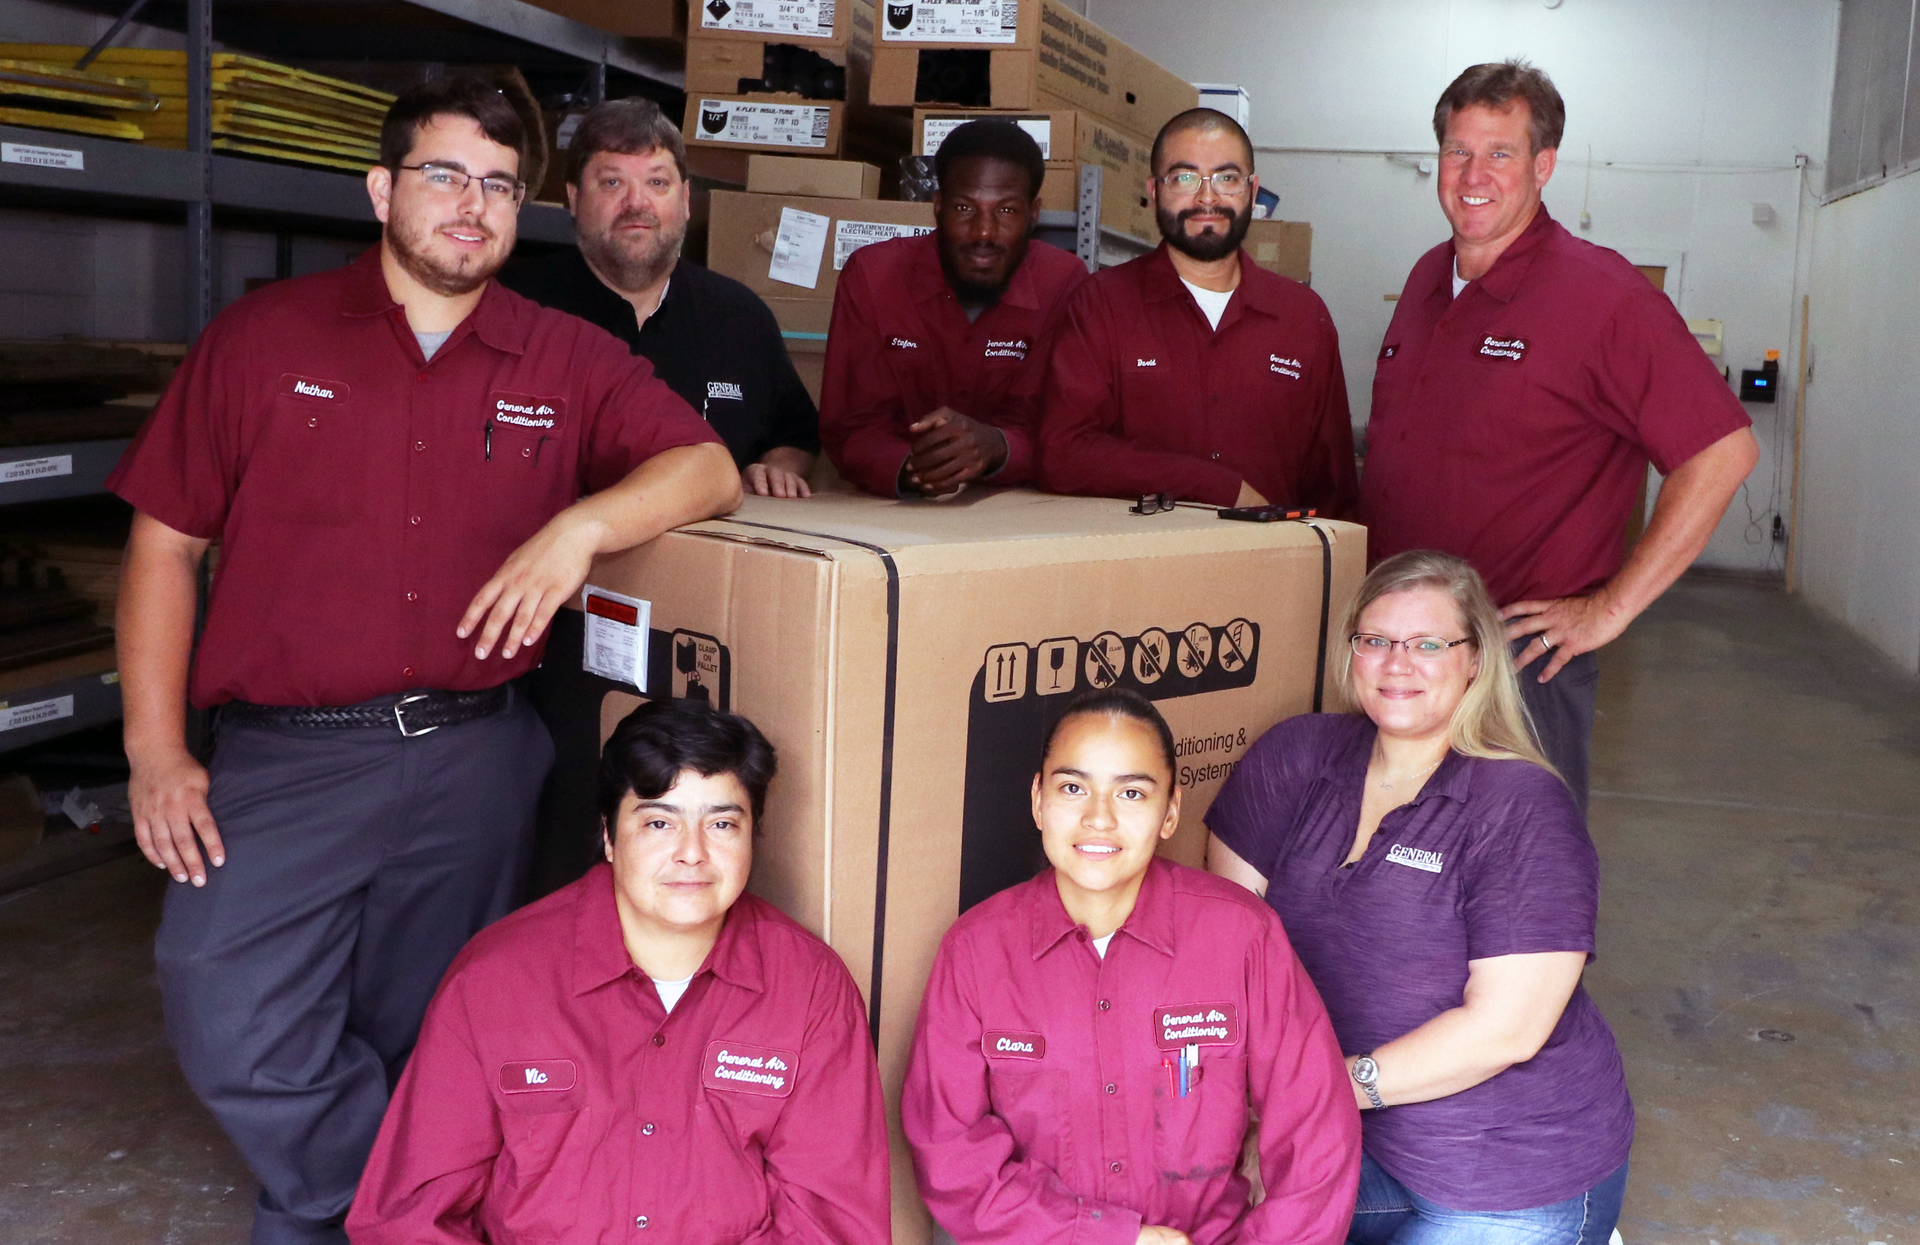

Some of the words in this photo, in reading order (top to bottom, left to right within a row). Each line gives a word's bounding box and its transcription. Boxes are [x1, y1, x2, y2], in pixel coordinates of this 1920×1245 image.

[779, 4, 795, 13] 3/4"
[797, 6, 805, 14] ID
[893, 7, 909, 16] 1/2"
[991, 9, 999, 18] ID
[708, 113, 724, 121] 1/2"
[774, 117, 789, 126] 7/8"
[791, 119, 799, 127] ID
[841, 228, 873, 236] ELECTRIC
[847, 223, 897, 232] SUPPLEMENTARY
[1484, 336, 1511, 347] General
[1511, 340, 1525, 349] Air
[984, 349, 1025, 360] Conditioning
[1137, 358, 1156, 366] David
[1291, 359, 1302, 368] Air
[1270, 363, 1300, 379] Conditioning
[294, 380, 334, 398] Nathan
[707, 381, 741, 394] GENERAL
[496, 399, 534, 415] General
[535, 404, 555, 415] Air
[496, 412, 555, 428] Conditioning
[697, 643, 718, 654] CLAMP
[703, 653, 711, 662] ON
[697, 661, 718, 673] PALLET
[1236, 727, 1246, 746] &
[1390, 844, 1443, 865] GENERAL
[1162, 1013, 1203, 1026] General
[1206, 1010, 1226, 1022] Air
[1164, 1026, 1228, 1040] Conditioning
[996, 1038, 1034, 1053] Clara
[716, 1050, 764, 1069] General
[765, 1057, 788, 1071] Air
[525, 1068, 548, 1084] Vic
[714, 1065, 785, 1089] Conditioning
